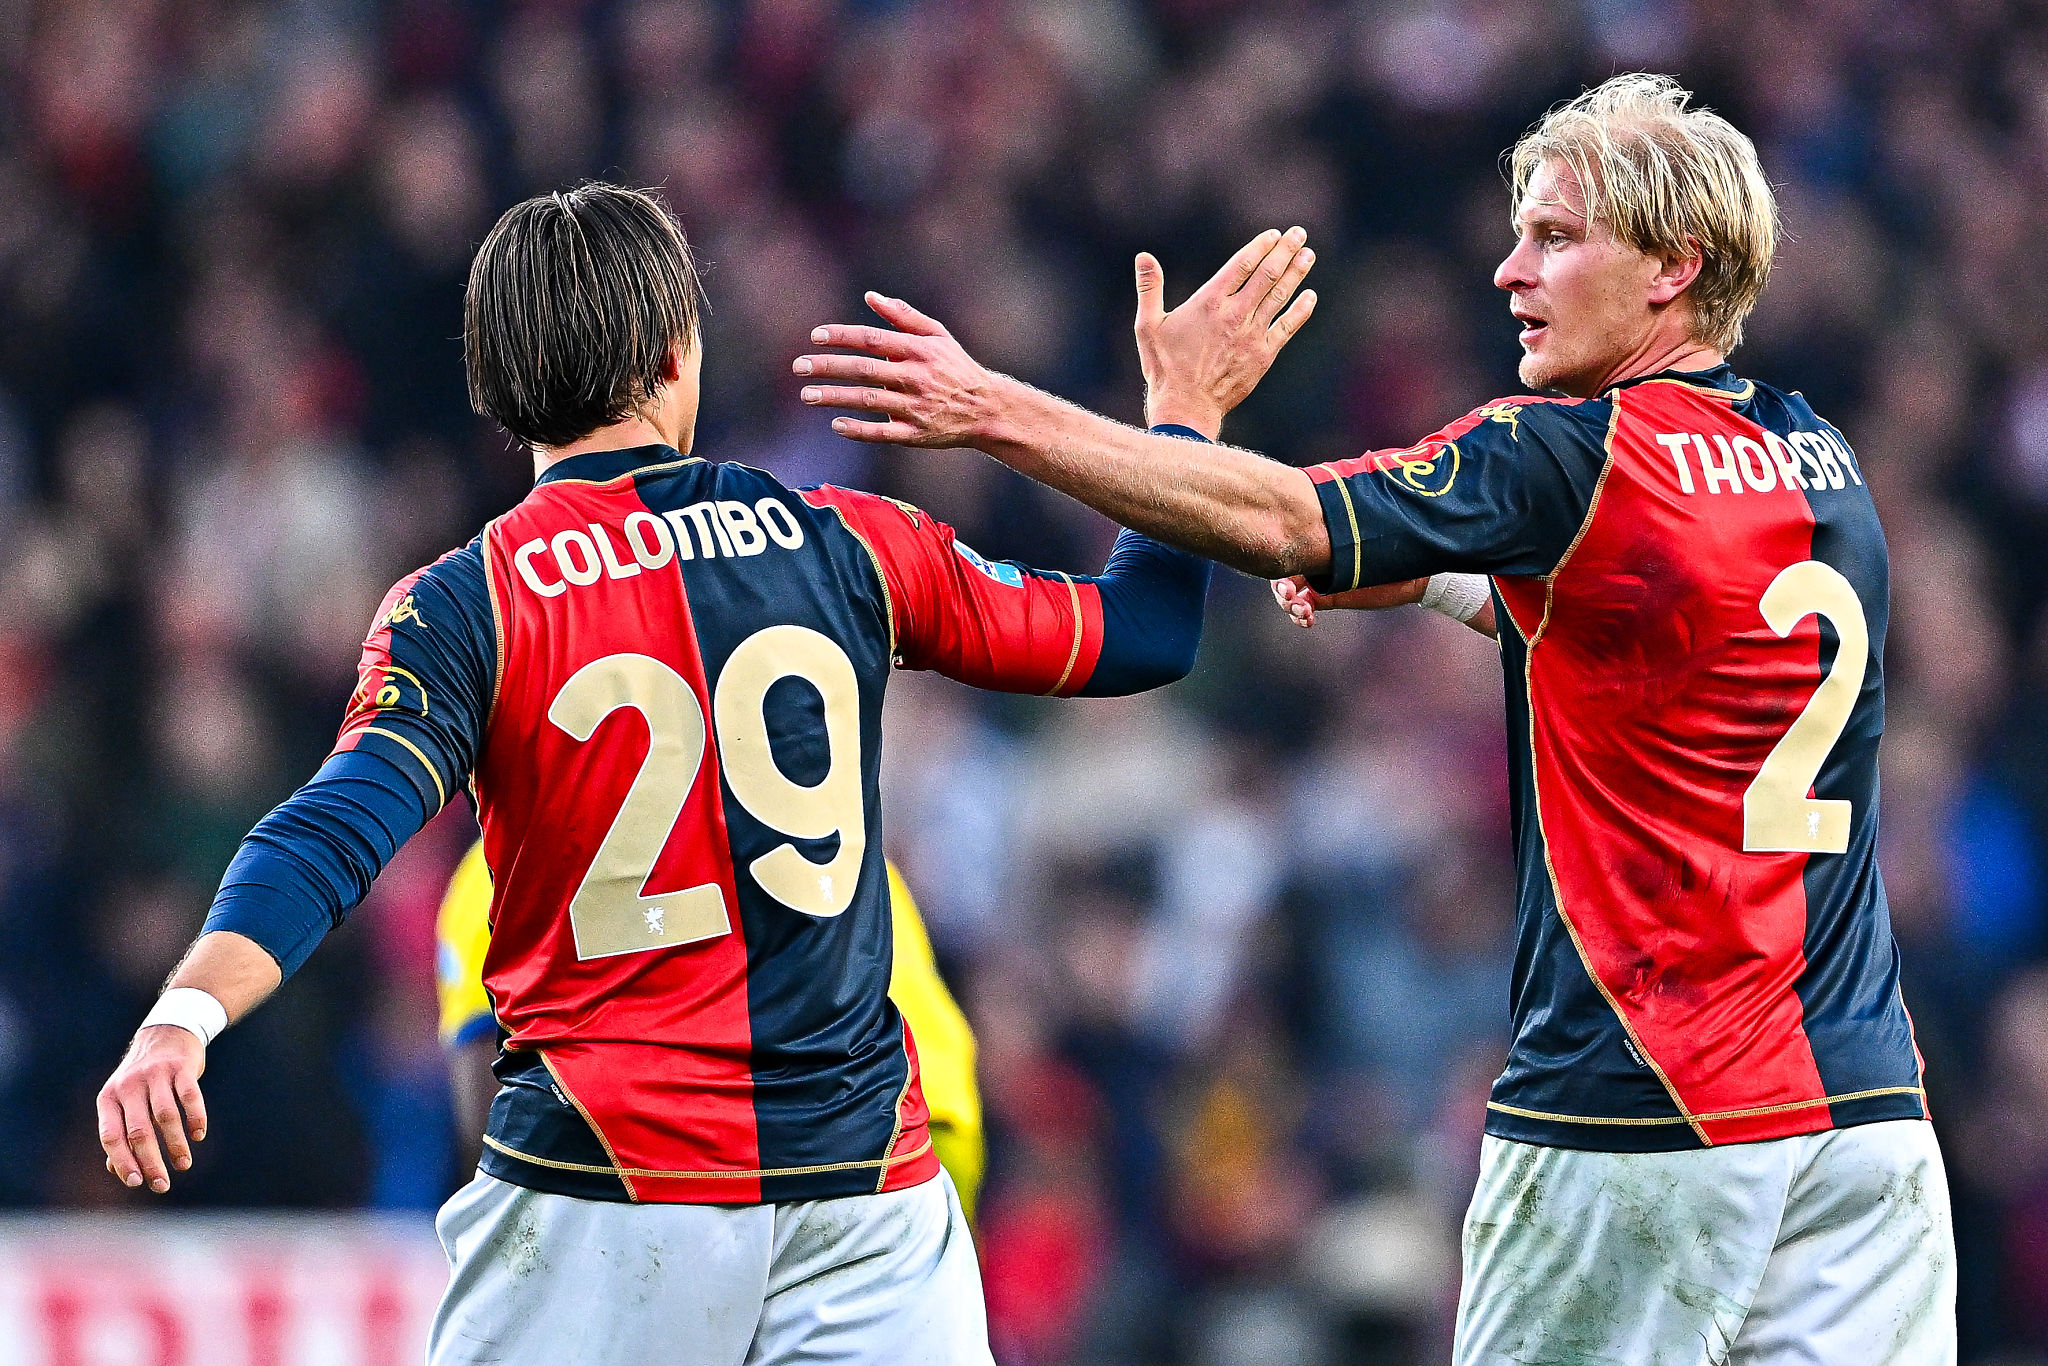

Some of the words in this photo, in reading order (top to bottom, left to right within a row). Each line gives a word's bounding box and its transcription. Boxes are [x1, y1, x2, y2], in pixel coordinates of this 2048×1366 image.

[514, 497, 804, 597] COLOMBO
[1655, 429, 1863, 494] THORSBY
[548, 625, 866, 961] 29
[1743, 561, 1868, 854] 2
